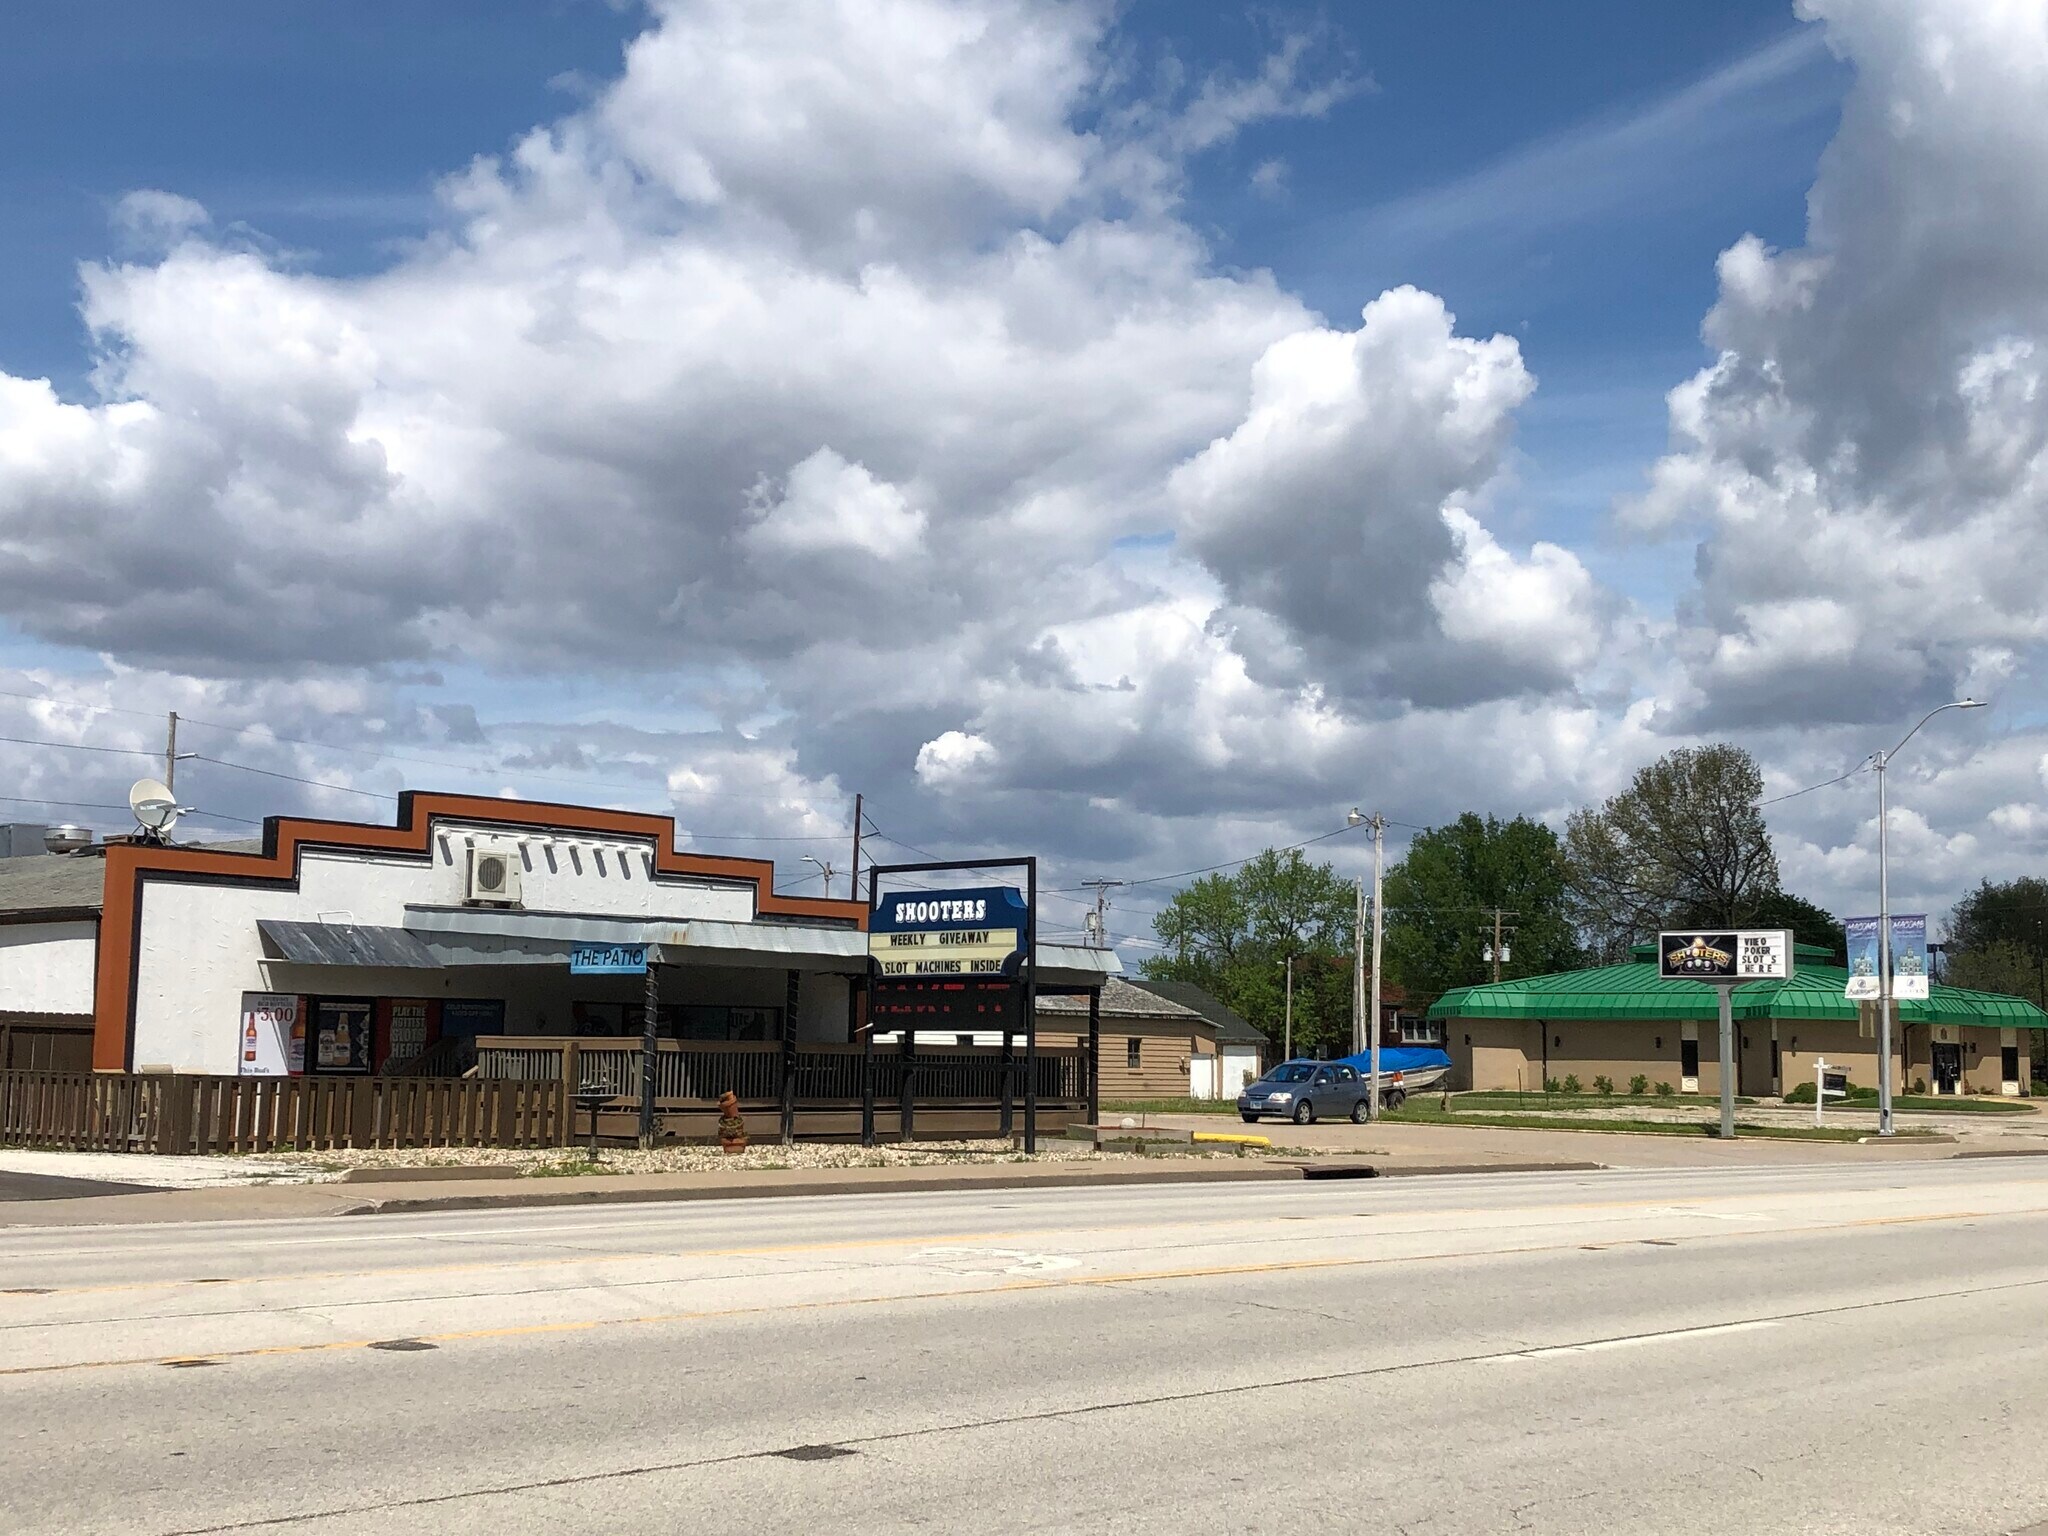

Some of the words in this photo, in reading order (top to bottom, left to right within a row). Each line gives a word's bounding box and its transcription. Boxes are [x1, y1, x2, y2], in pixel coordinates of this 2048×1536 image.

[895, 899, 987, 923] SHOOTERS
[890, 933, 926, 946] WEEKLY
[939, 931, 989, 945] GIVEAWAY
[573, 950, 599, 966] THE
[602, 949, 643, 965] PATIO
[1669, 947, 1728, 963] SHOOTERS
[1744, 946, 1771, 955] POKER
[884, 961, 908, 974] SLOT
[915, 960, 961, 973] MACHINES
[970, 959, 1001, 972] INSIDE
[392, 1006, 410, 1017] PLAY
[411, 1006, 426, 1017] THE
[392, 1017, 426, 1028] HOTTEST
[392, 1028, 425, 1042] SLOTS
